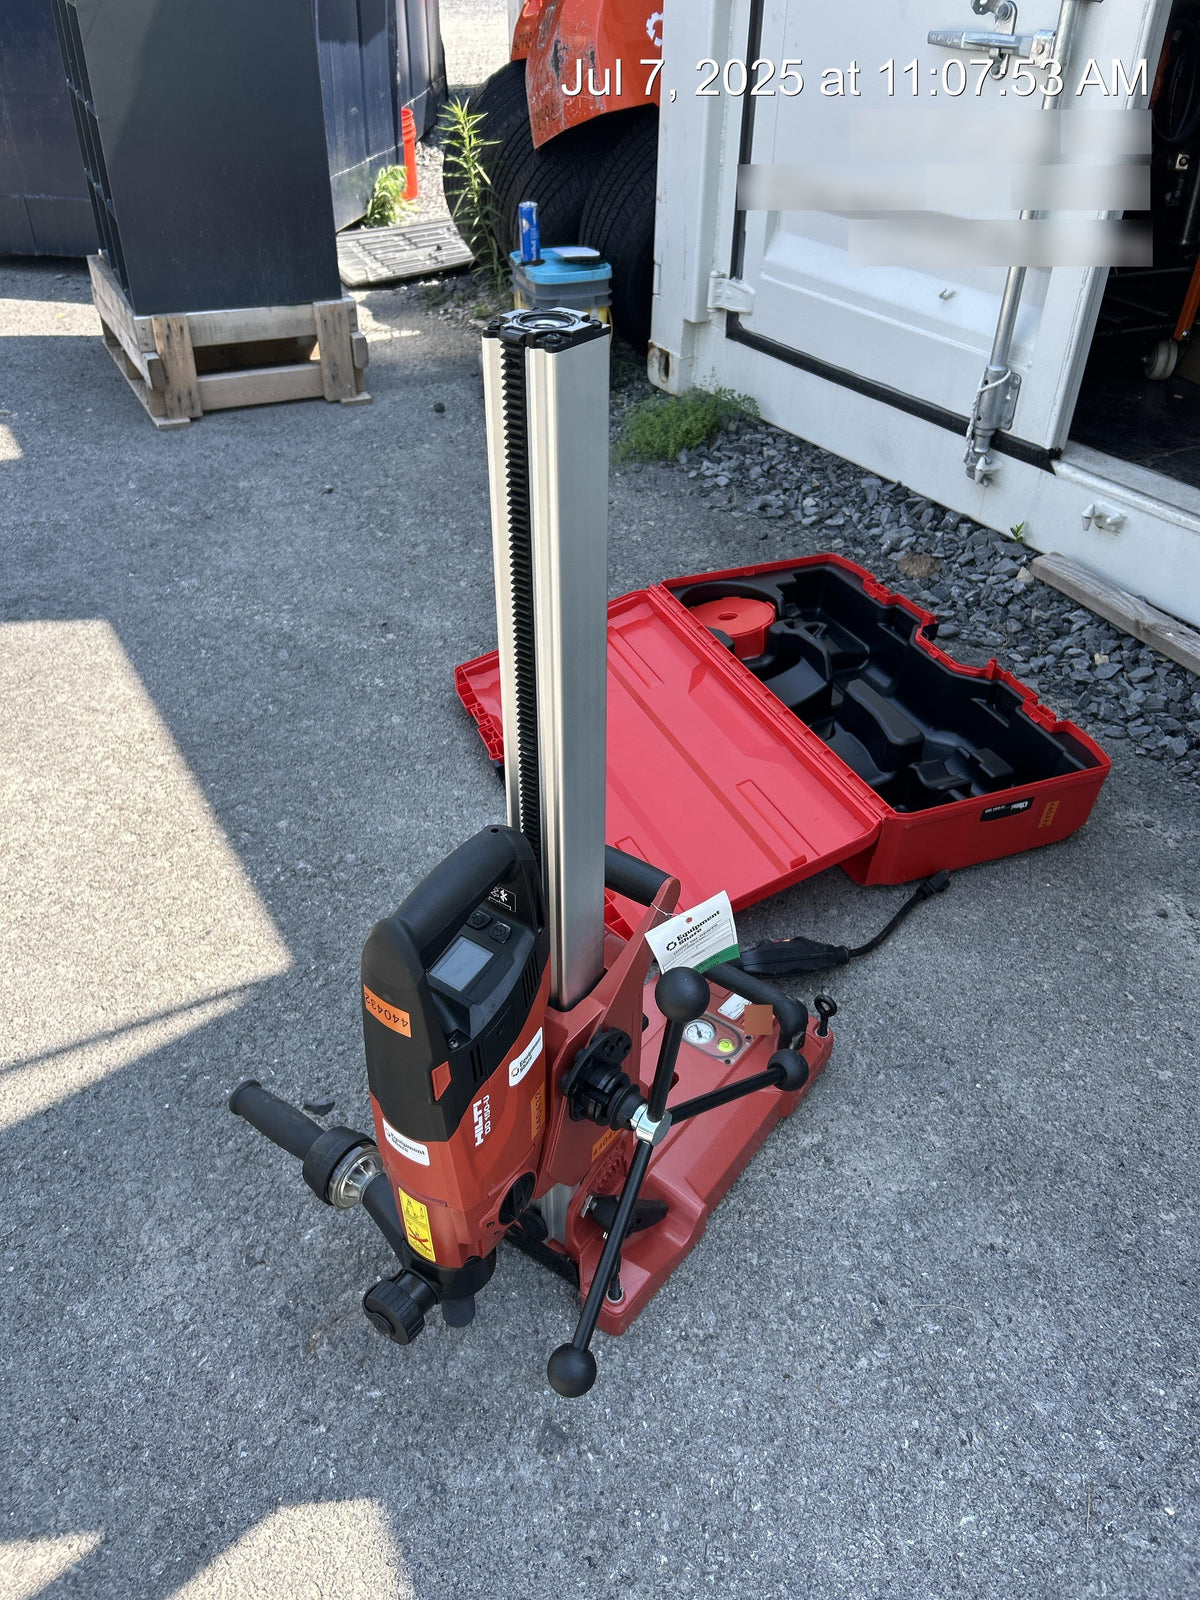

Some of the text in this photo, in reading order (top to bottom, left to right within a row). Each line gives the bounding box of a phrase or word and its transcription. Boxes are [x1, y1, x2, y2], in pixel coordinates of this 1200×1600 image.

[676, 909, 721, 942] Equipment
[678, 928, 703, 946] Share
[364, 993, 409, 1028] 440432
[473, 1099, 484, 1147] HILTI
[484, 1120, 492, 1135] DD
[390, 1131, 426, 1156] Equipment
